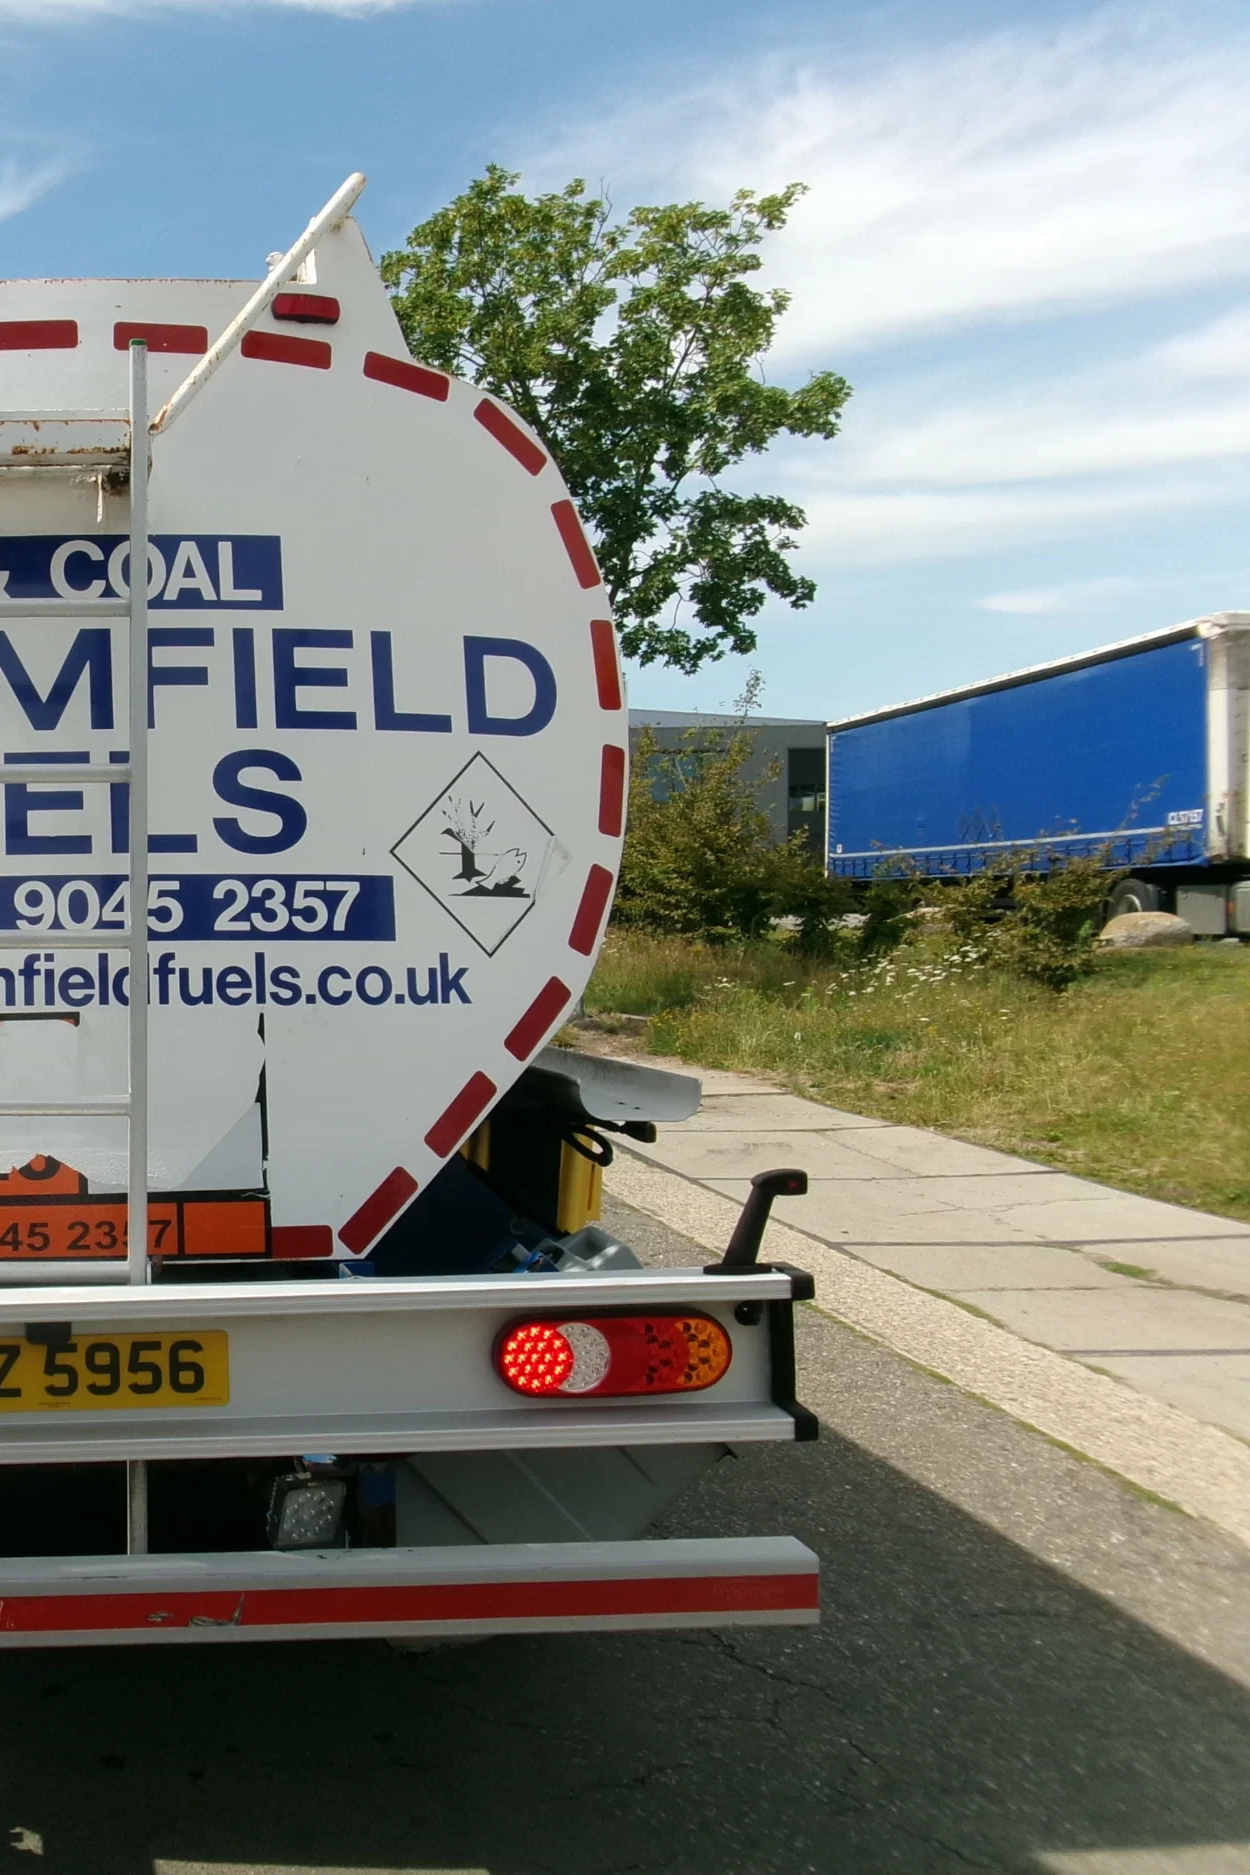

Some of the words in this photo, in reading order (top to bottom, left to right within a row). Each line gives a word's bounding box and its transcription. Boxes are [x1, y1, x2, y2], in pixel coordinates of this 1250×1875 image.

[50, 539, 262, 601] COAL
[13, 879, 184, 933] 9045
[212, 879, 361, 933] 2357
[67, 1219, 172, 1251] 237
[43, 1340, 205, 1396] 5956
